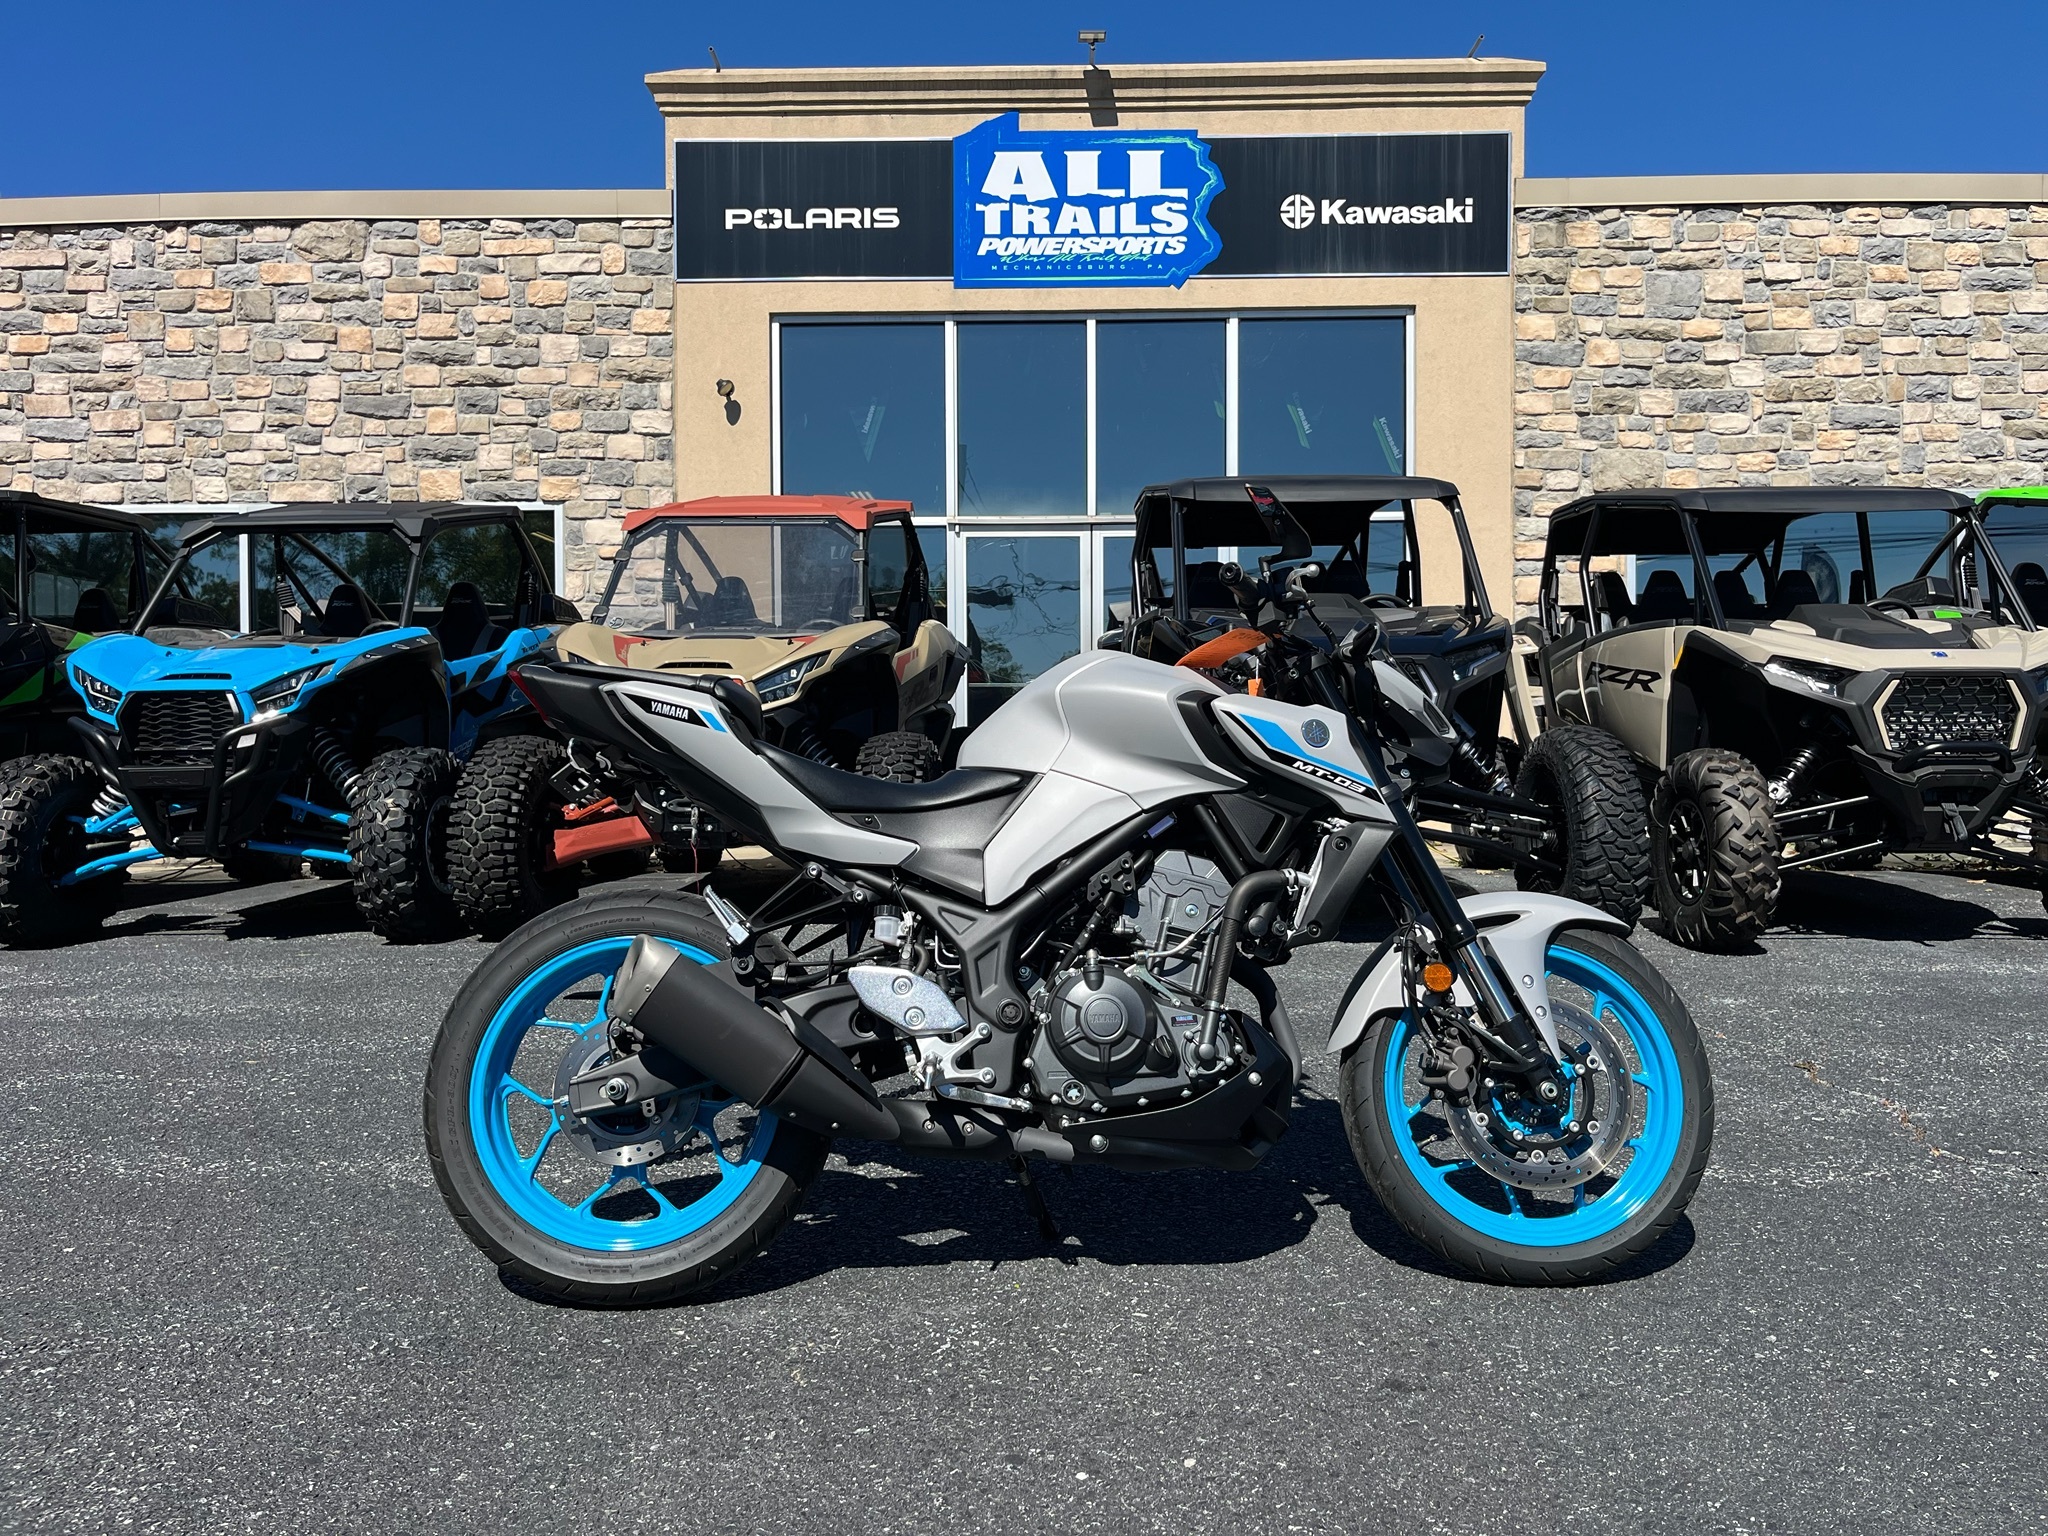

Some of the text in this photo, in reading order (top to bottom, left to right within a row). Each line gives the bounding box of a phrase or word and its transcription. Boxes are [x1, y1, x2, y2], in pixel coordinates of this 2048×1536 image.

[981, 150, 1189, 202] ALL
[725, 207, 900, 230] POLARIS
[975, 201, 1189, 235] TRAILS
[1321, 197, 1474, 225] Kawasaki
[977, 236, 1188, 256] POWERSPORTS
[1378, 416, 1403, 460] Kawasaki
[1585, 661, 1663, 694] RZR
[650, 700, 690, 720] YAMAHA
[1292, 760, 1367, 793] MT-03
[1089, 1013, 1121, 1024] YAMAHA
